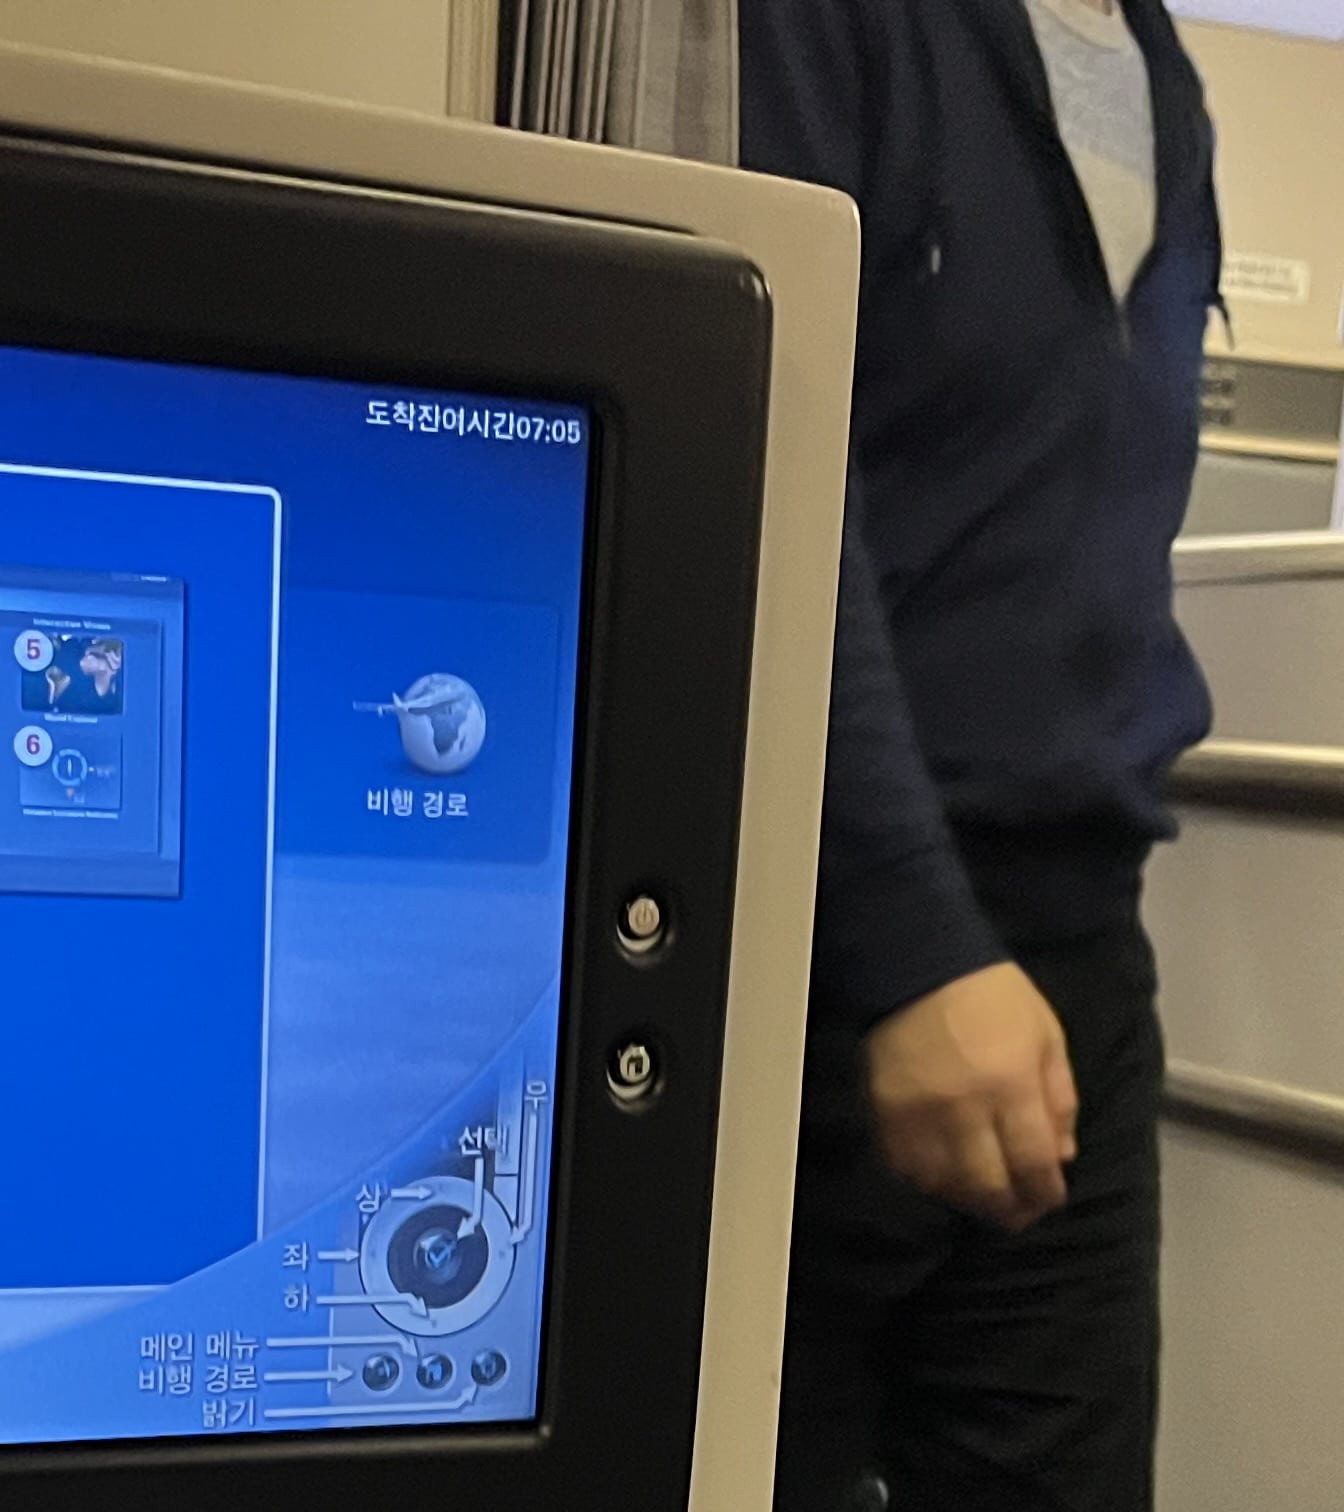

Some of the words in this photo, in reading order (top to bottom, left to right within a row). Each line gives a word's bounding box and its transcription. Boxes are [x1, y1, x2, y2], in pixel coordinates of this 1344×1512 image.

[26, 639, 41, 661] 5
[26, 733, 41, 755] 6
[367, 788, 413, 817] 비행
[423, 791, 469, 818] 경로
[457, 1124, 510, 1157] 선택
[282, 1242, 310, 1272] 좌
[282, 1285, 310, 1313] 하
[139, 1334, 194, 1363] 메인
[205, 1331, 260, 1361] 메뉴
[137, 1364, 192, 1396] 비행
[203, 1362, 258, 1393] 경로
